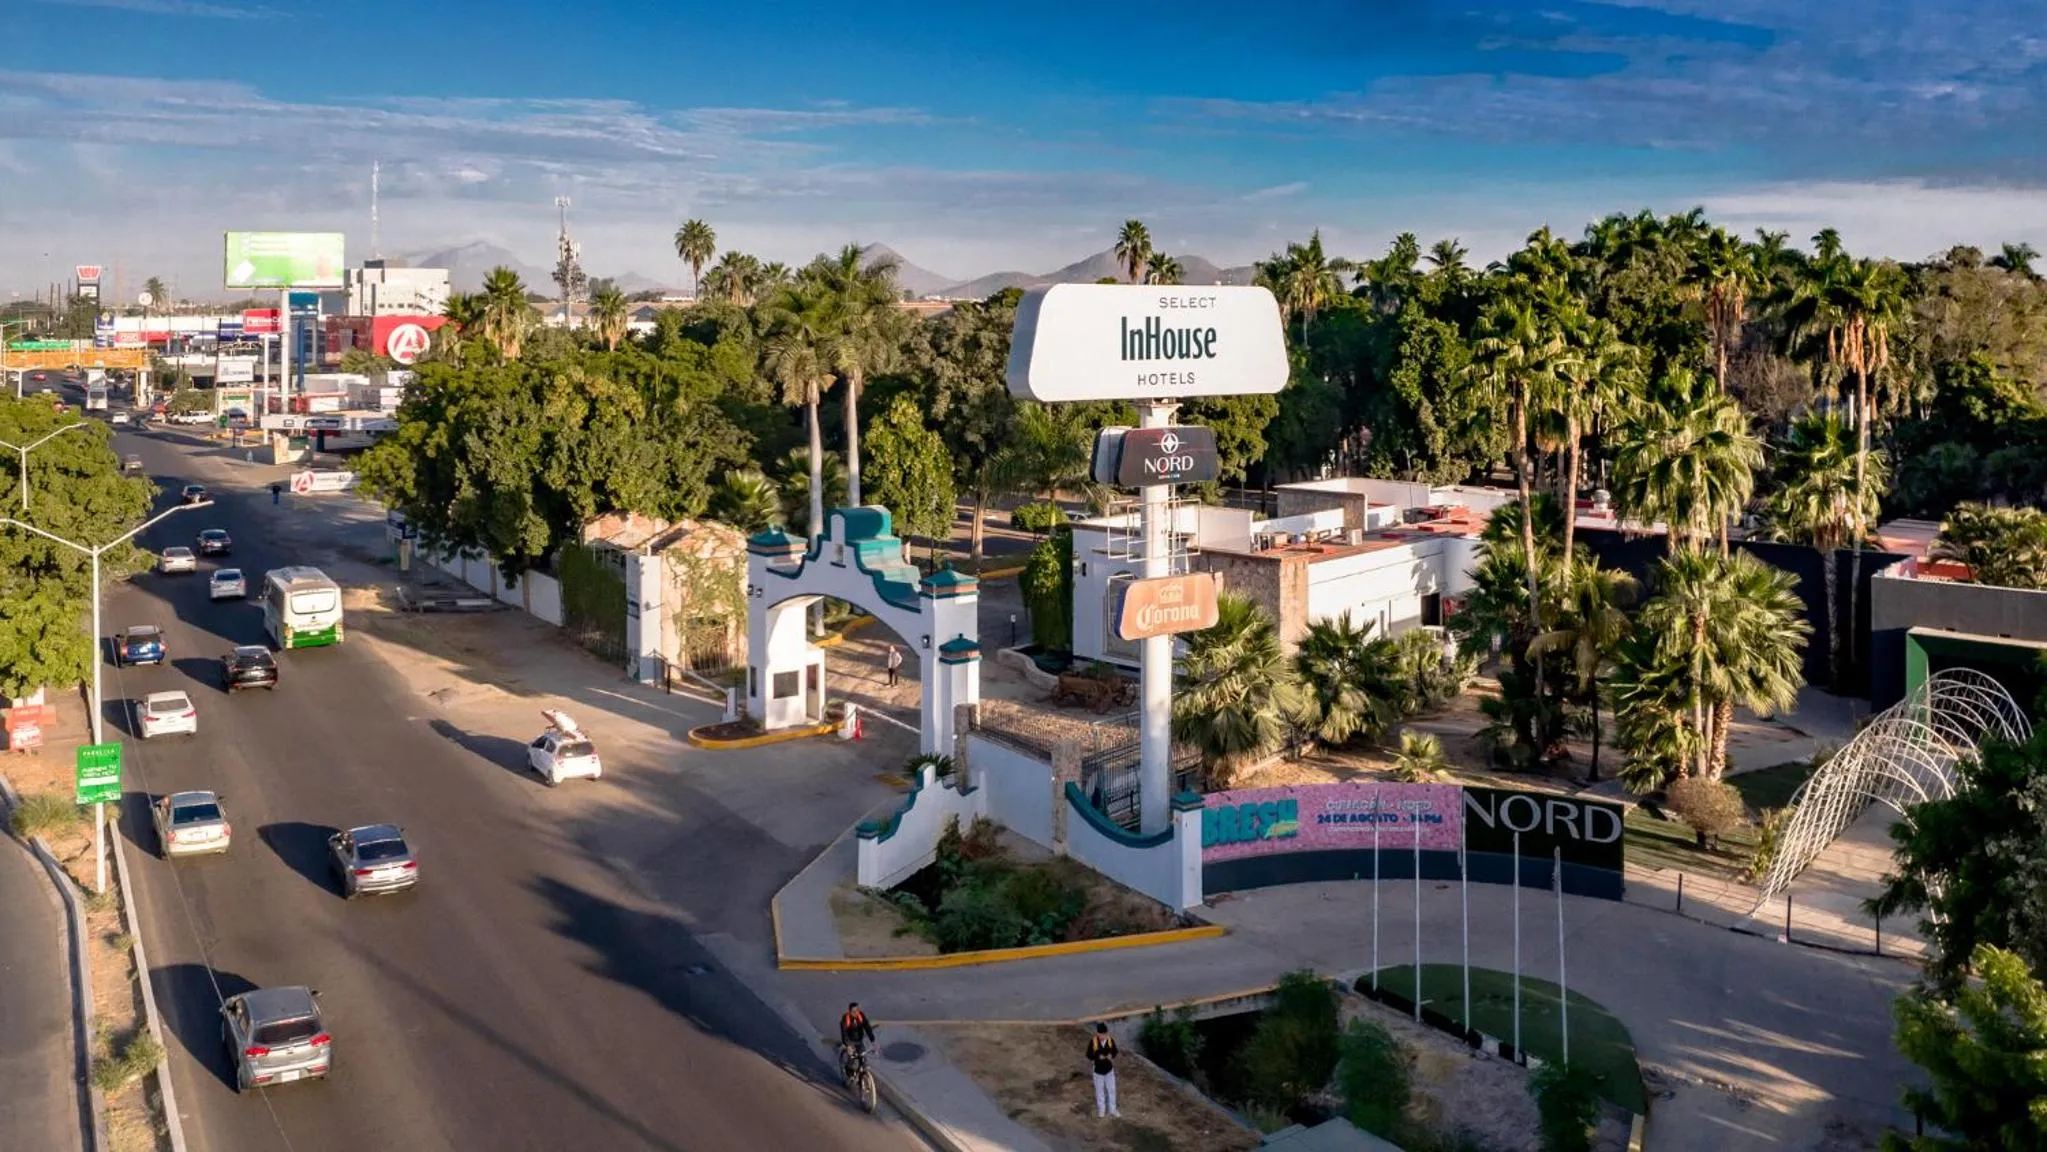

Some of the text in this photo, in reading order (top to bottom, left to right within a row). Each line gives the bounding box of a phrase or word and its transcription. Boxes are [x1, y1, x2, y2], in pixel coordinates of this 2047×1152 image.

[1159, 297, 1217, 309] SELECT
[1121, 316, 1217, 361] InHouse
[1137, 371, 1196, 386] HOTELS
[1144, 455, 1194, 474] NORD
[1136, 604, 1200, 632] Corona
[1333, 813, 1347, 823] DE
[1462, 790, 1622, 844] NORD
